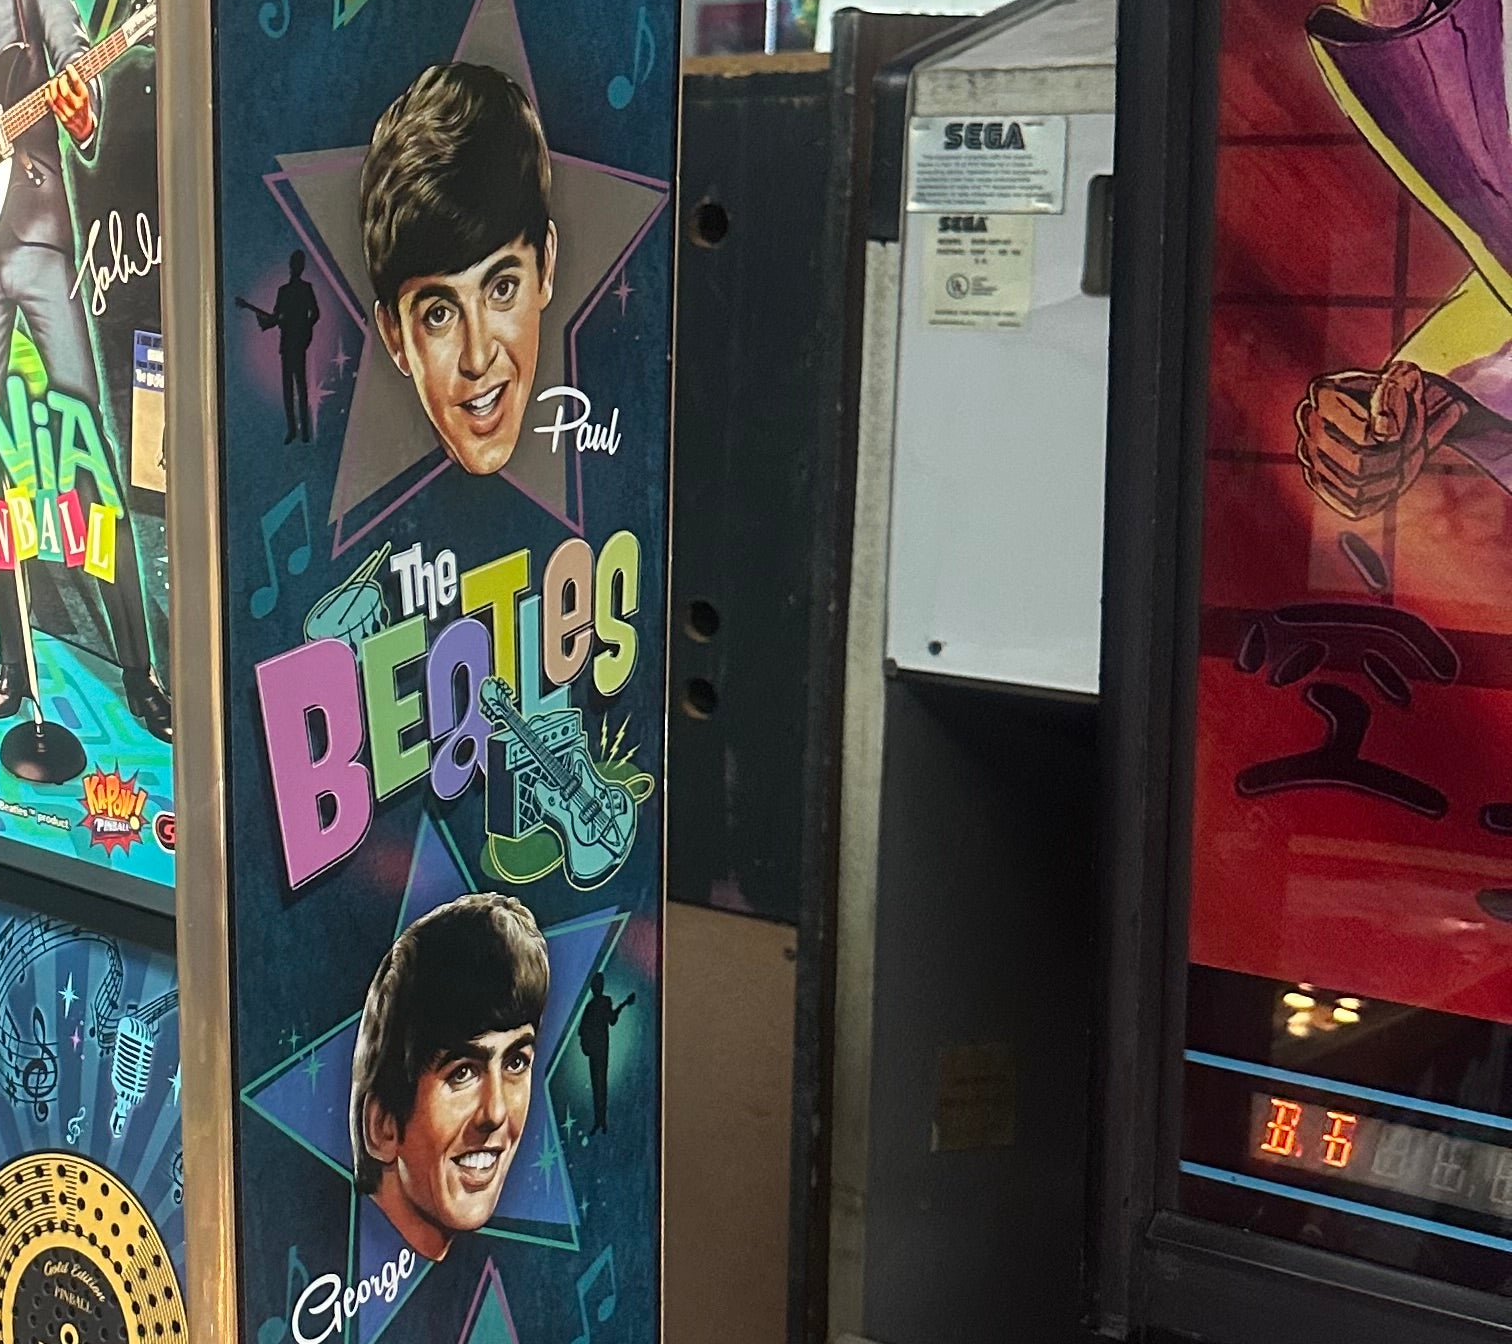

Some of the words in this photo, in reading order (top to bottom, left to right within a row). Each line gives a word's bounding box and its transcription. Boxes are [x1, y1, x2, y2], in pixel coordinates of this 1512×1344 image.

[944, 123, 1025, 150] SEGA
[938, 216, 987, 233] SEGA
[532, 386, 621, 455] Paul
[390, 542, 457, 621] The
[37, 813, 71, 832] product.
[94, 817, 130, 833] PINBALL
[43, 1260, 70, 1276] Gold
[70, 1264, 106, 1302] Edition
[54, 1285, 93, 1314] PINBALL
